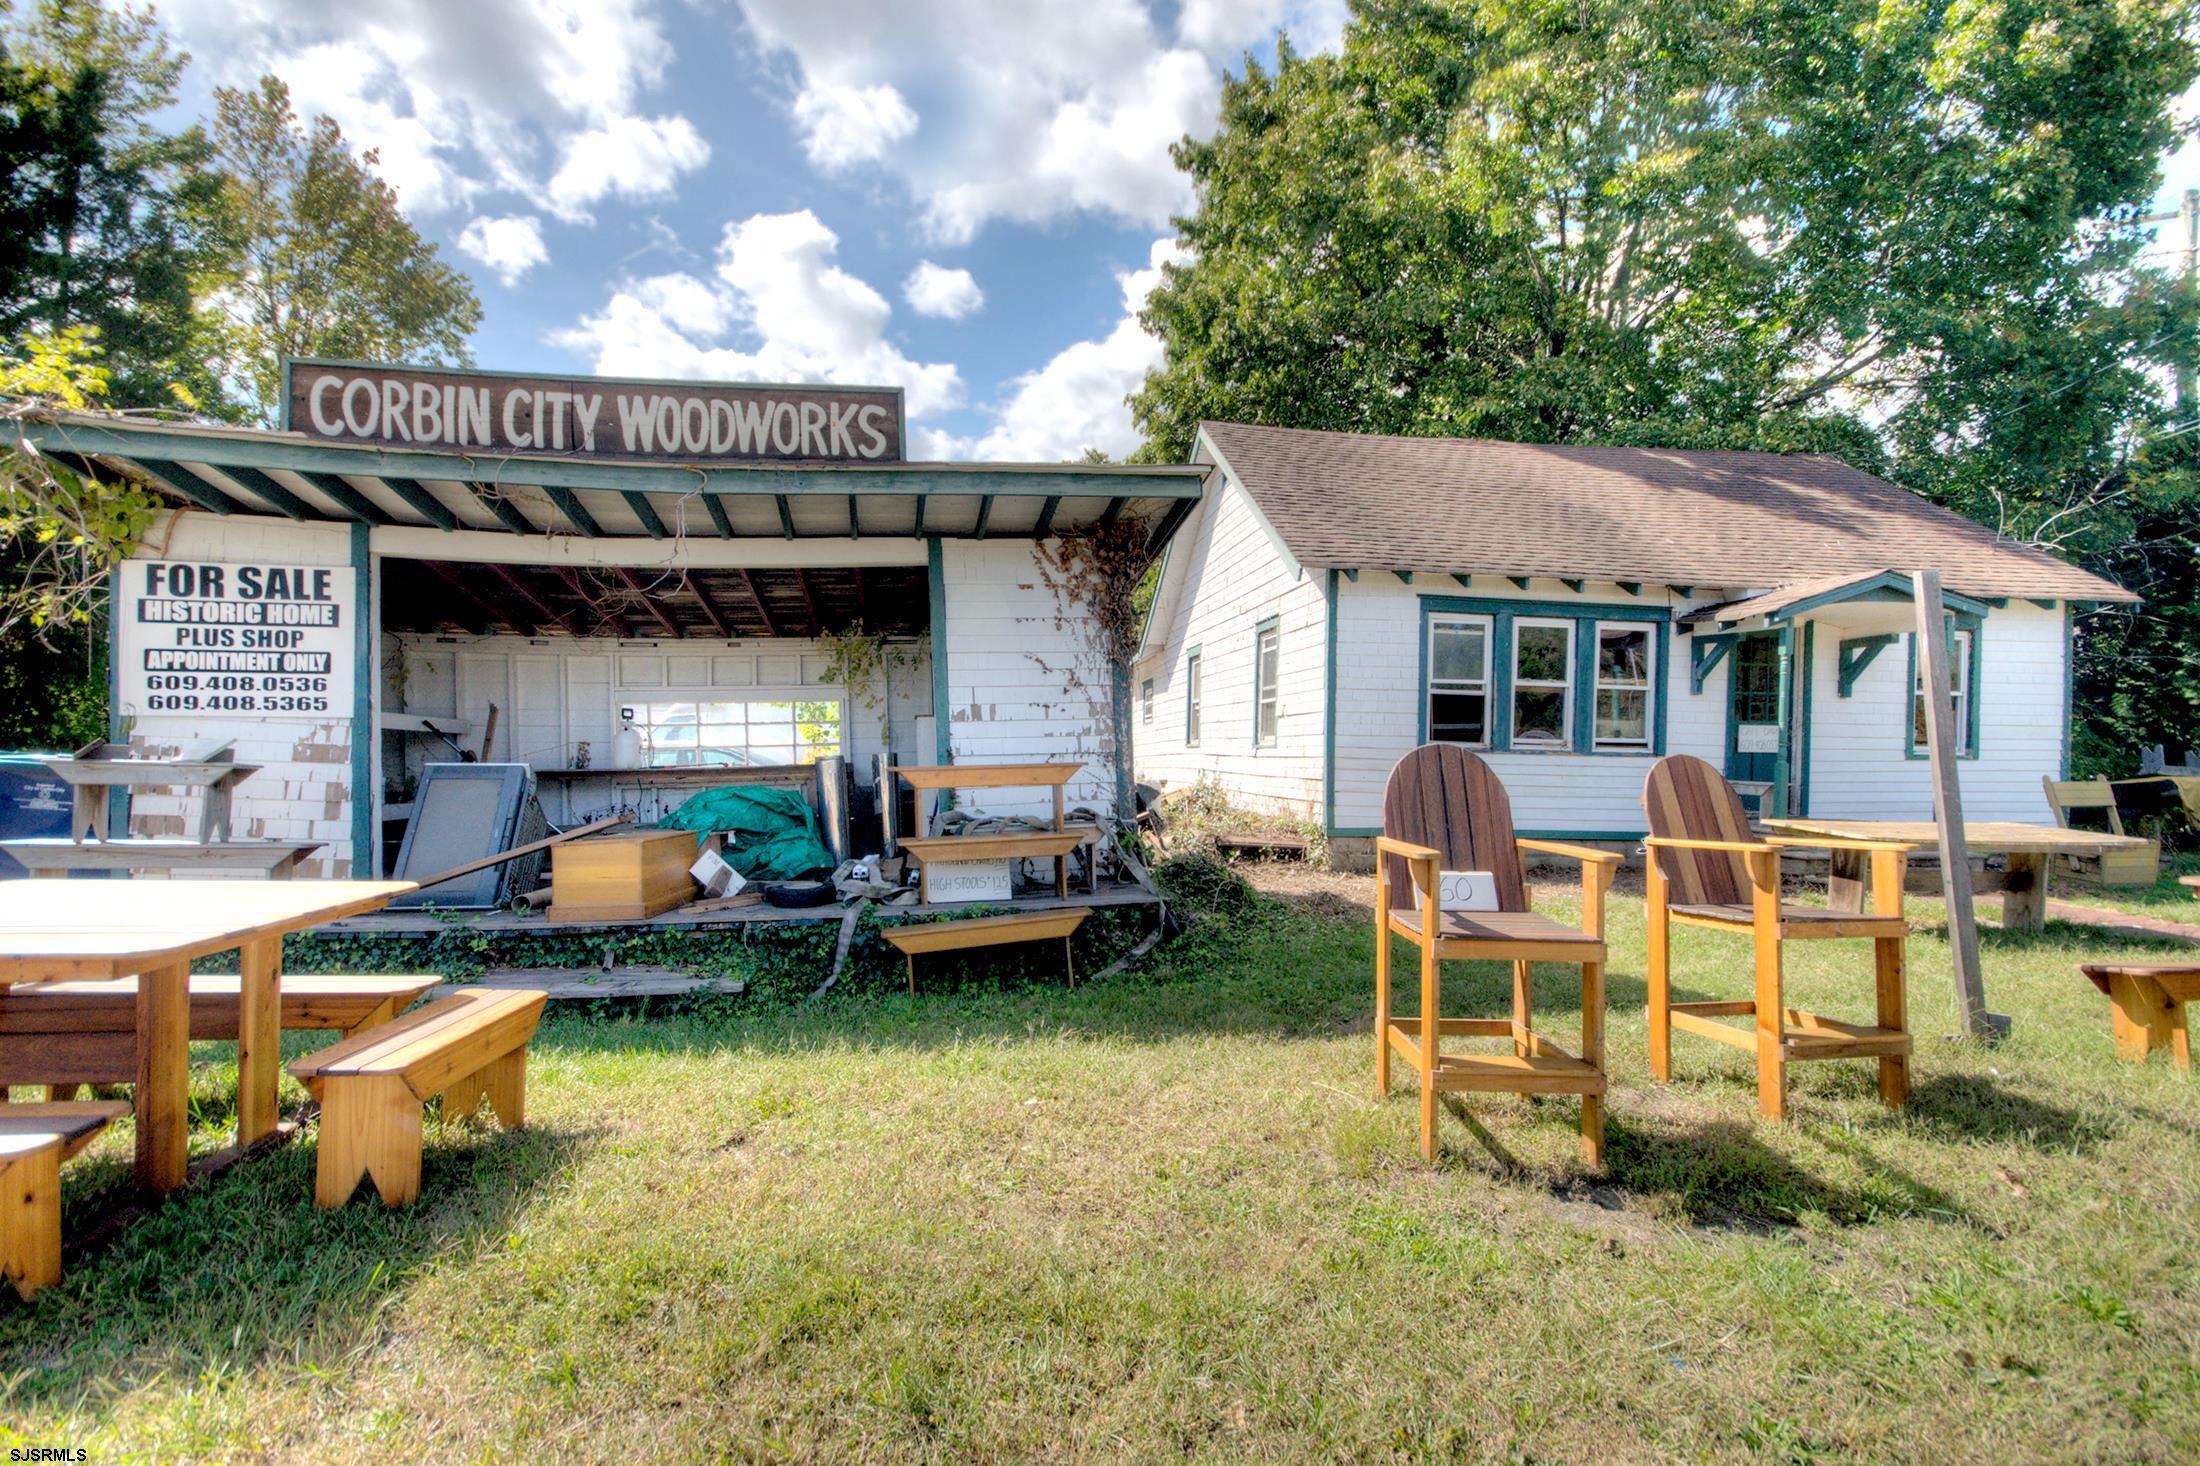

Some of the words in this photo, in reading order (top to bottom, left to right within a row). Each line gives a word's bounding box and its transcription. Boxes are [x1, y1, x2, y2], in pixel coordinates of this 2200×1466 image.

[309, 375, 492, 446] CORBIN
[502, 388, 603, 451] CITY
[616, 393, 888, 459] WOODWORKS
[146, 563, 225, 598] FOR
[238, 567, 332, 601] SALE
[144, 600, 263, 625] HISTORIC
[266, 604, 334, 626] HOME
[176, 627, 235, 647] PLUS
[242, 629, 304, 648] SHOP
[147, 650, 281, 672] APPOINTMENT
[283, 652, 328, 672] ONLY
[147, 675, 328, 692] 609.408.0536
[147, 695, 328, 711] 609.408.5365
[929, 877, 952, 891] HIGH
[953, 876, 987, 890] STOOLS
